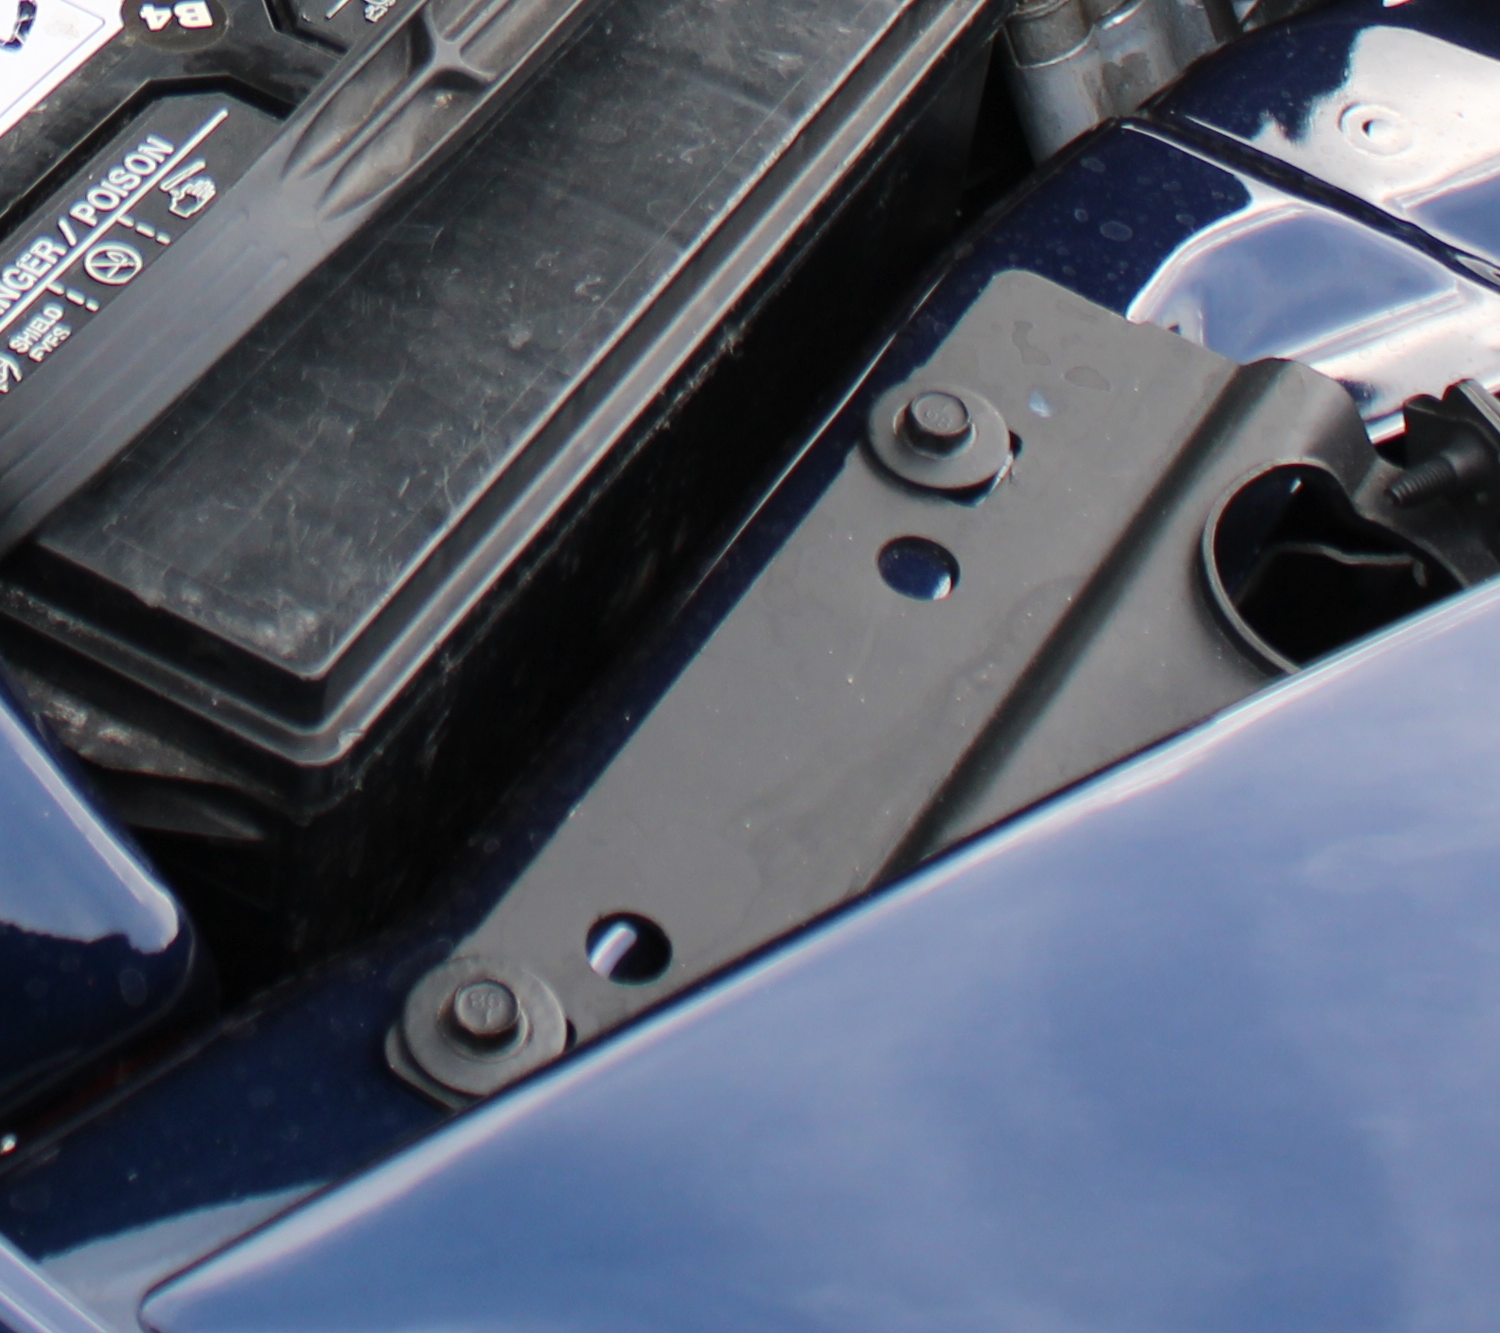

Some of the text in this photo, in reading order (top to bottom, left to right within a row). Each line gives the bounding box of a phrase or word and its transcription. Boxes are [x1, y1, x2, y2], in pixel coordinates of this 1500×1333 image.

[138, 0, 215, 32] B4
[69, 134, 175, 228] POISON
[8, 303, 64, 354] SHIELD
